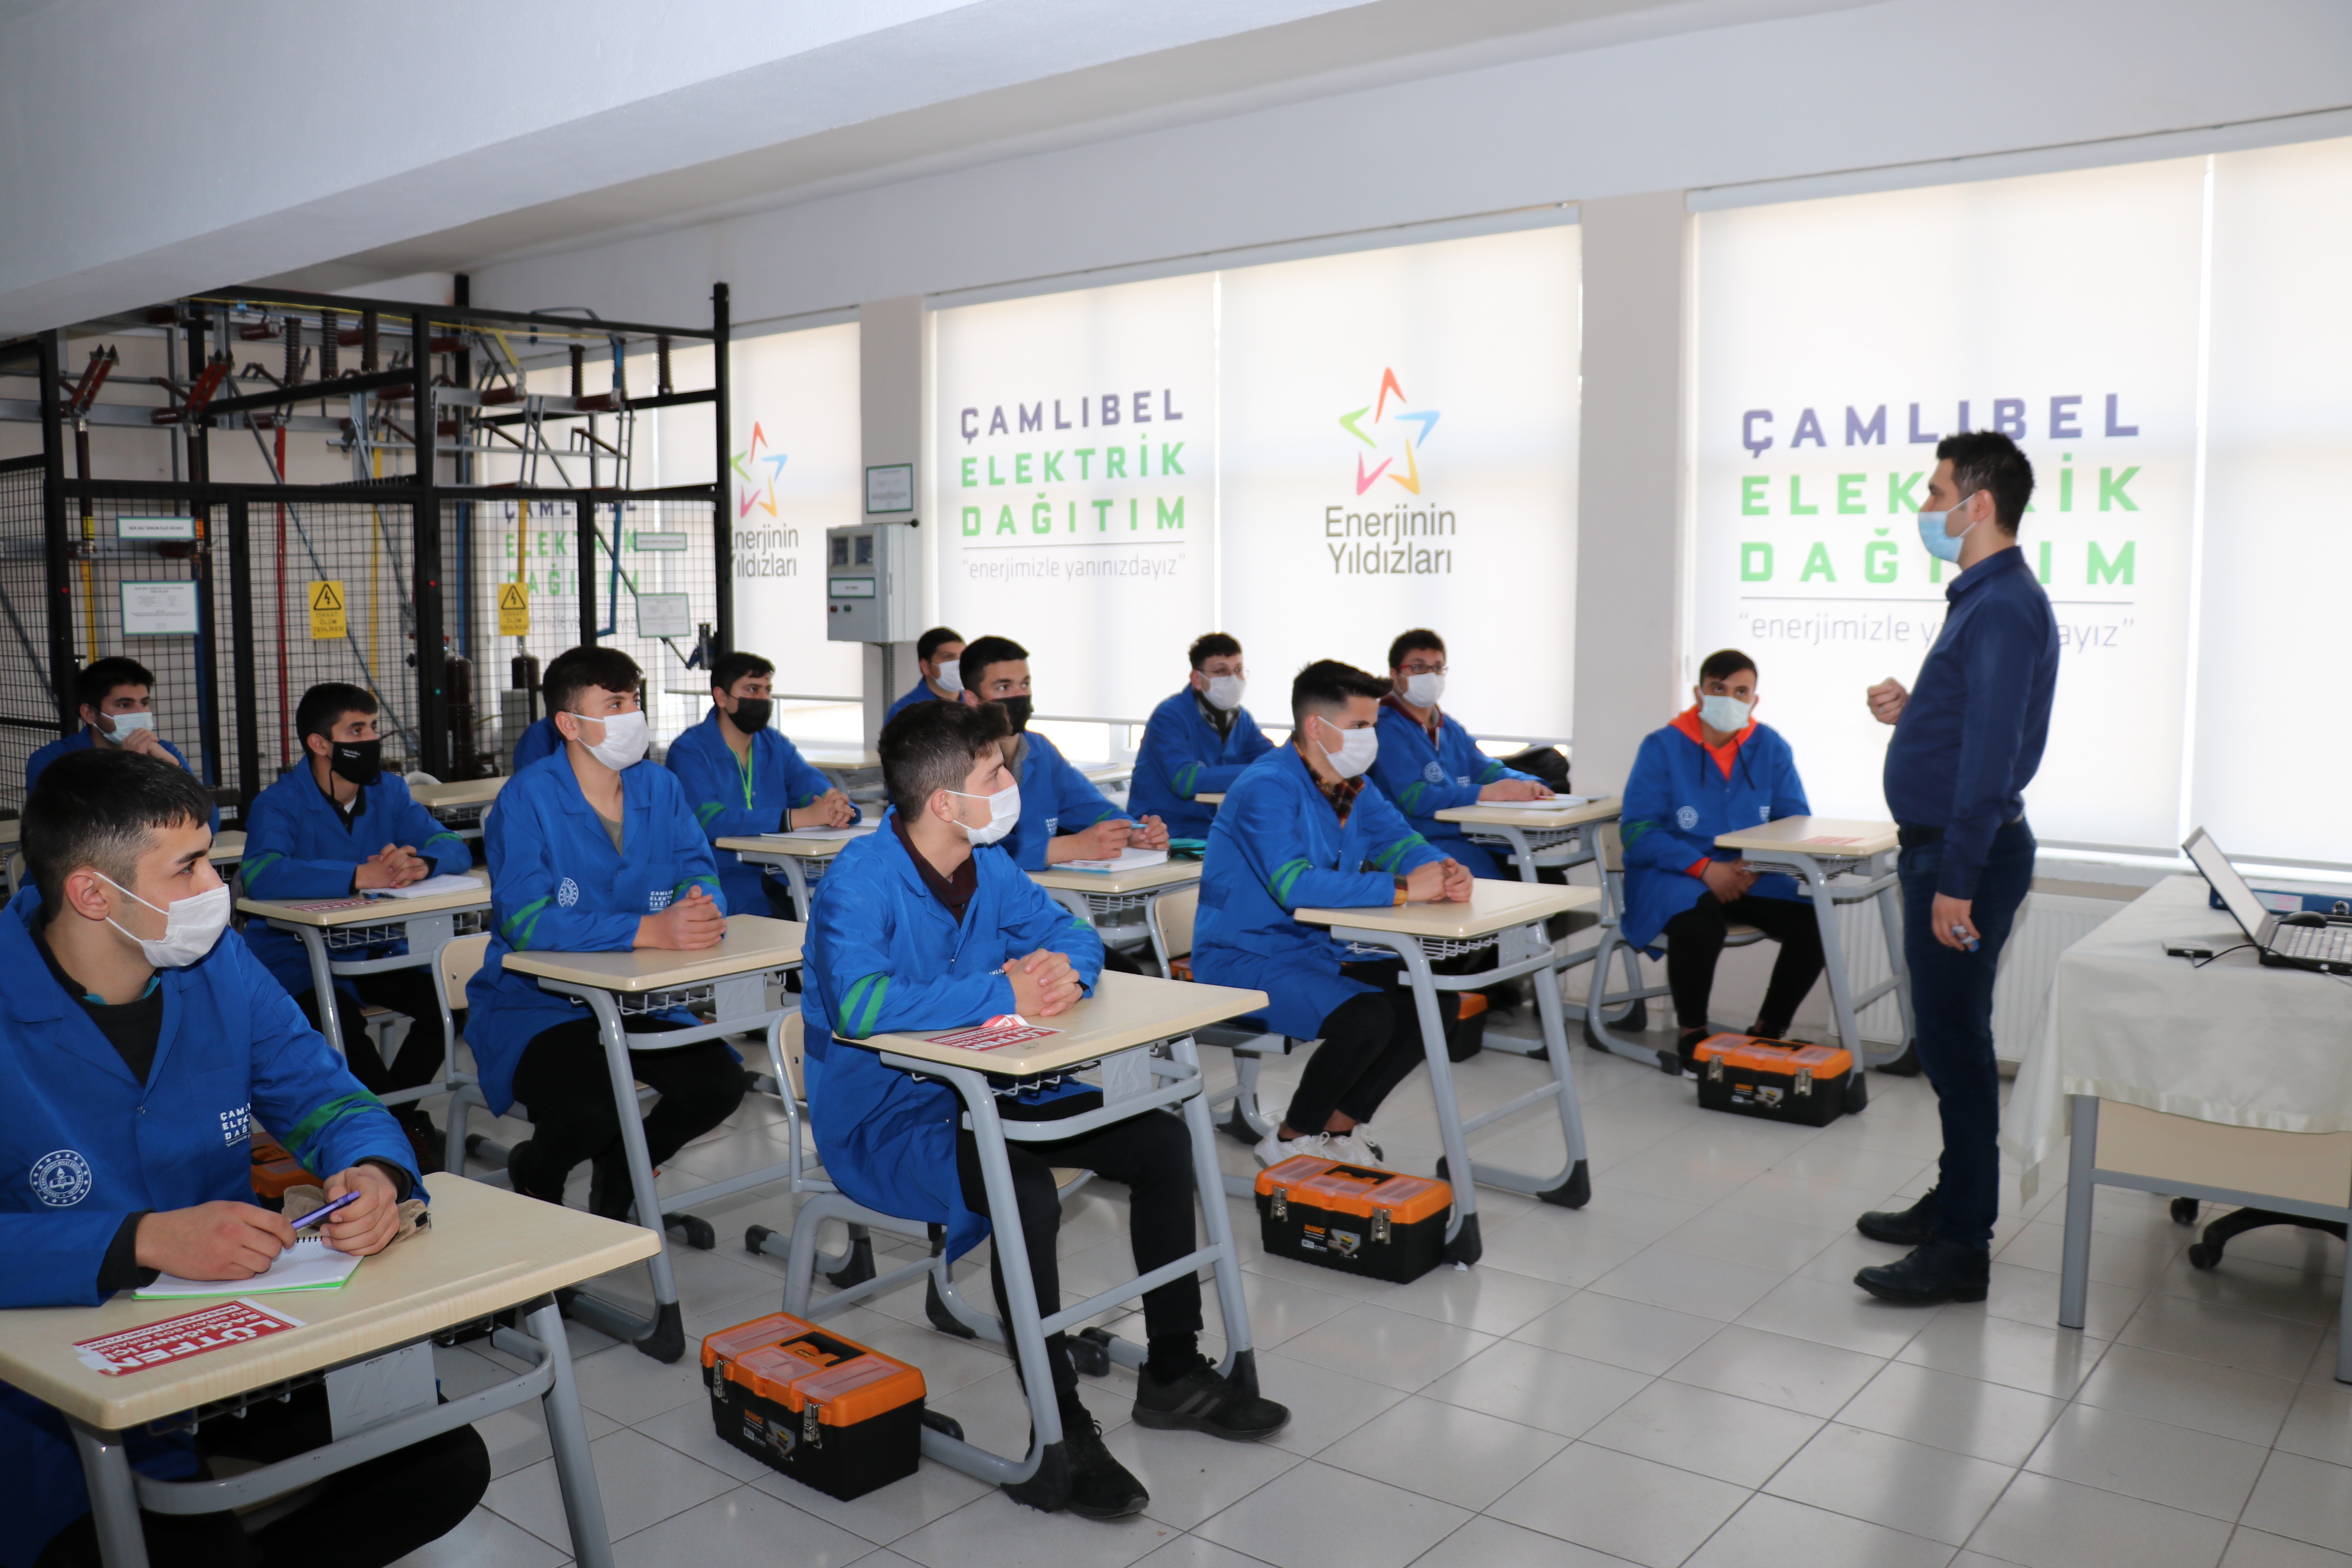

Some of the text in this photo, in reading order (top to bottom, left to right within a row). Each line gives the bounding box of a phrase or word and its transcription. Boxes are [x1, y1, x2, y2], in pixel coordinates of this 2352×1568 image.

[961, 388, 1183, 444] ÇAMLIBEL
[1743, 393, 2139, 458] ÇAMLIBEL
[962, 433, 1186, 487] ELEKTRİK
[1742, 452, 2142, 515] ELEKİK
[962, 492, 1184, 536] DAĞITIM
[1326, 502, 1456, 545] Enerjinin
[731, 523, 798, 556] nerjinin
[1328, 541, 1452, 574] Yıldızları
[1741, 527, 2135, 585] DAĞIIM
[964, 1029, 1050, 1049] LÜTFEN
[222, 1113, 251, 1131] ELEK
[84, 1327, 156, 1349] KORUYUNU
[105, 1314, 261, 1359] SAĞLIĞINIZ İÇİ
